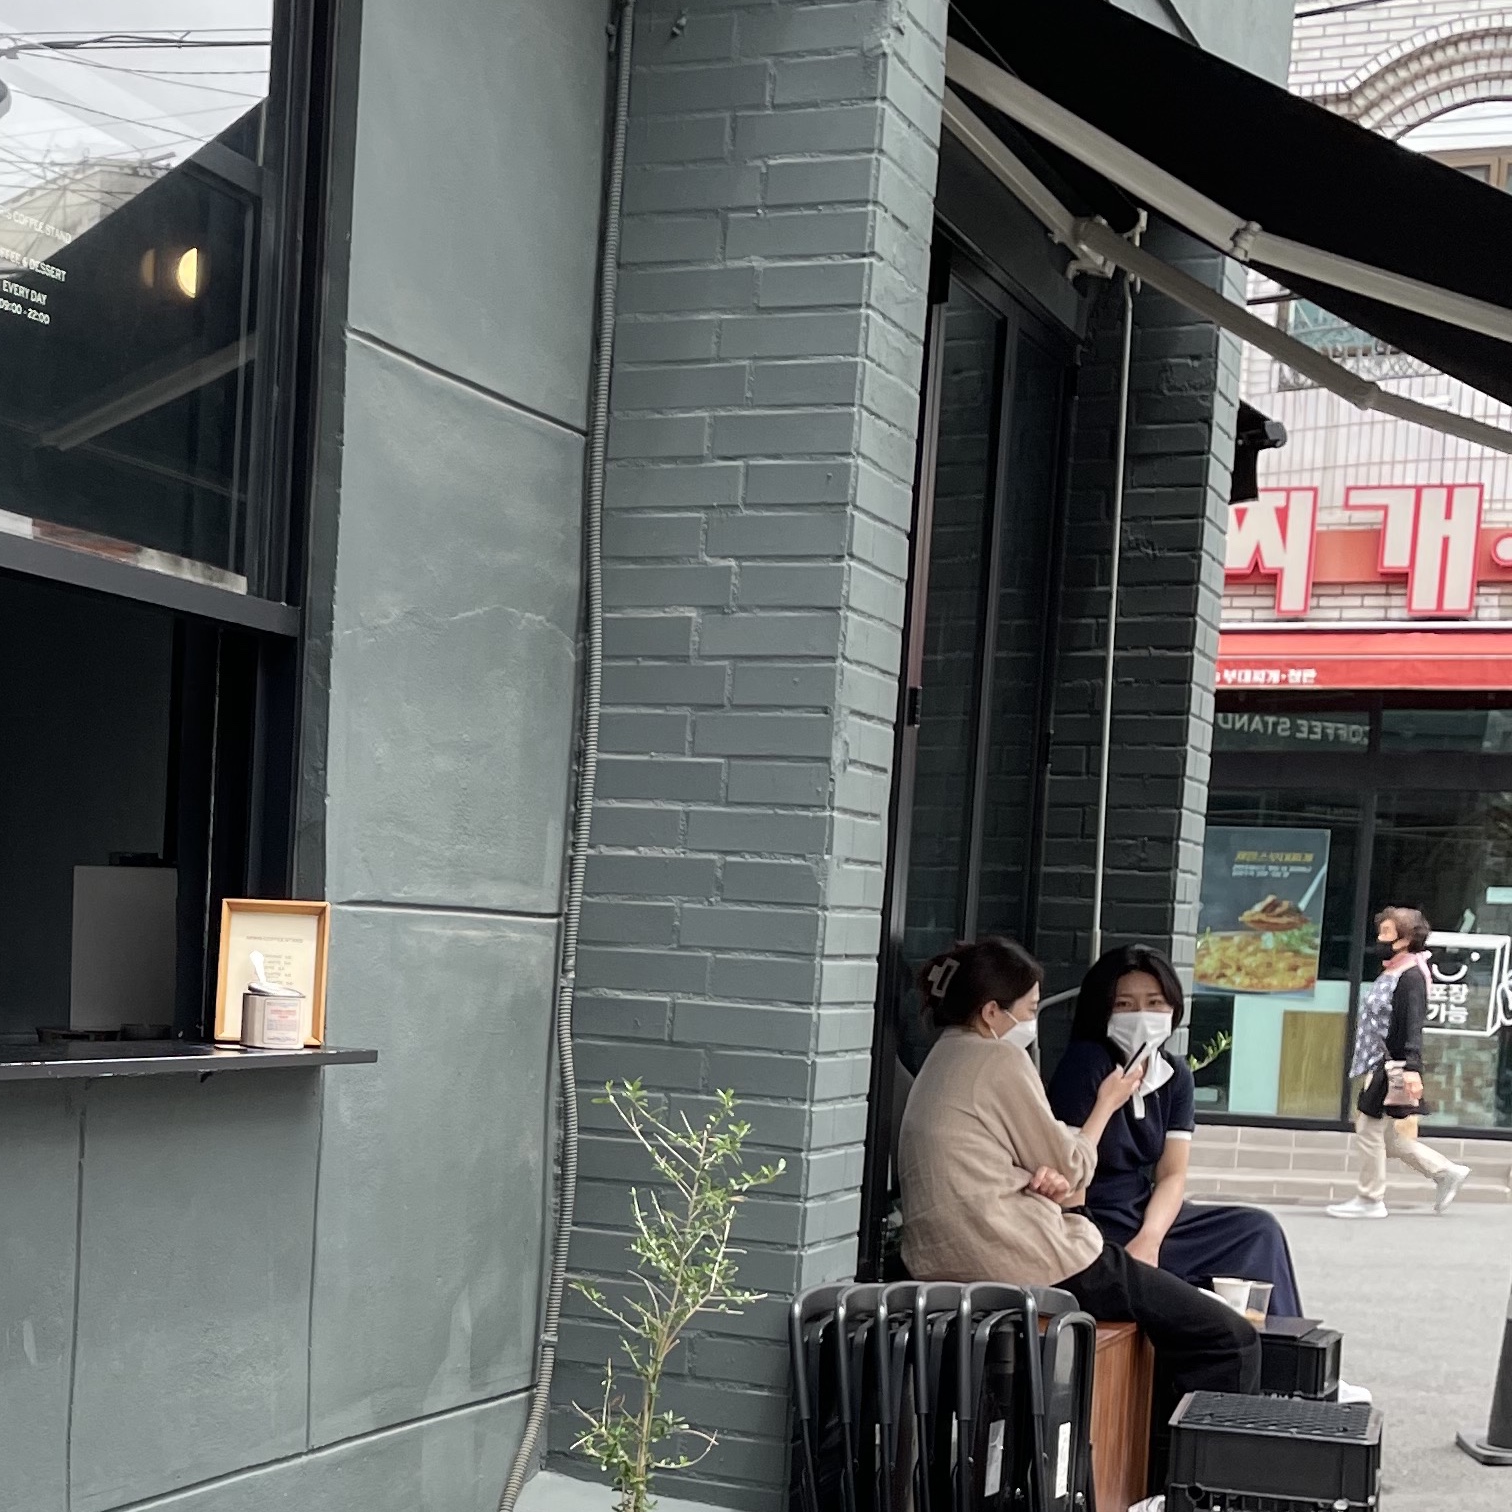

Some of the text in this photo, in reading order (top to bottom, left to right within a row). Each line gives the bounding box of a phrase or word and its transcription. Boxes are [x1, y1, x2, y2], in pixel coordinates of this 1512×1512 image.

[28, 258, 67, 282] DESSERT
[2, 279, 48, 306] EVERY DAY
[27, 308, 51, 325] 22:00
[1426, 1002, 1469, 1025] 가능
